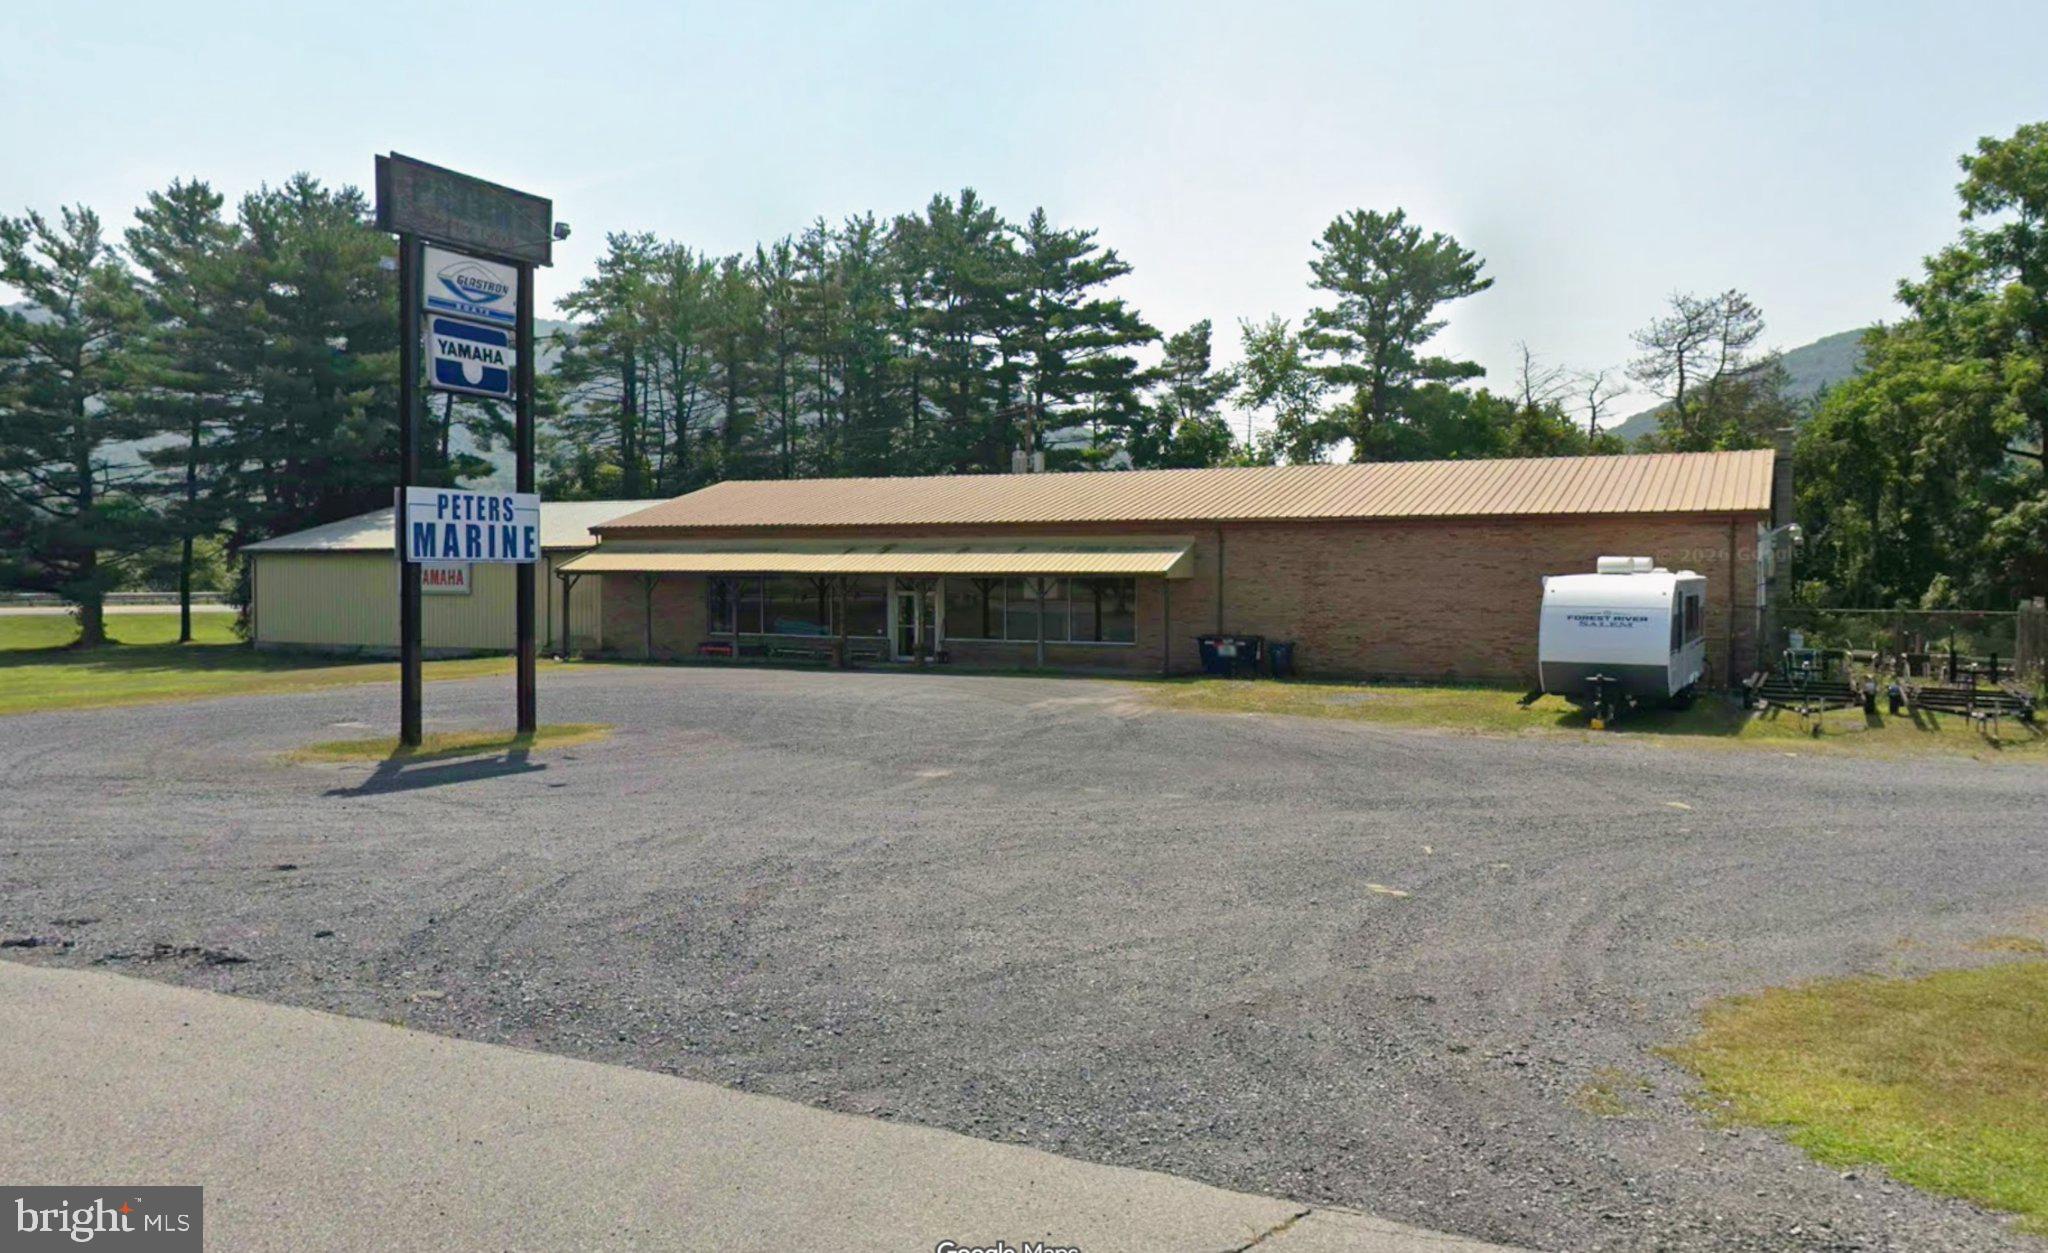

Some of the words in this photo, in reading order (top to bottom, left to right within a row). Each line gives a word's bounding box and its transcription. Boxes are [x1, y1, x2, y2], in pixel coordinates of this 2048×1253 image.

[456, 275, 509, 294] GLASTRON
[438, 339, 504, 366] YAMAHA
[437, 494, 514, 522] PETERS
[413, 522, 536, 558] MARINE
[423, 569, 464, 586] AMAHA
